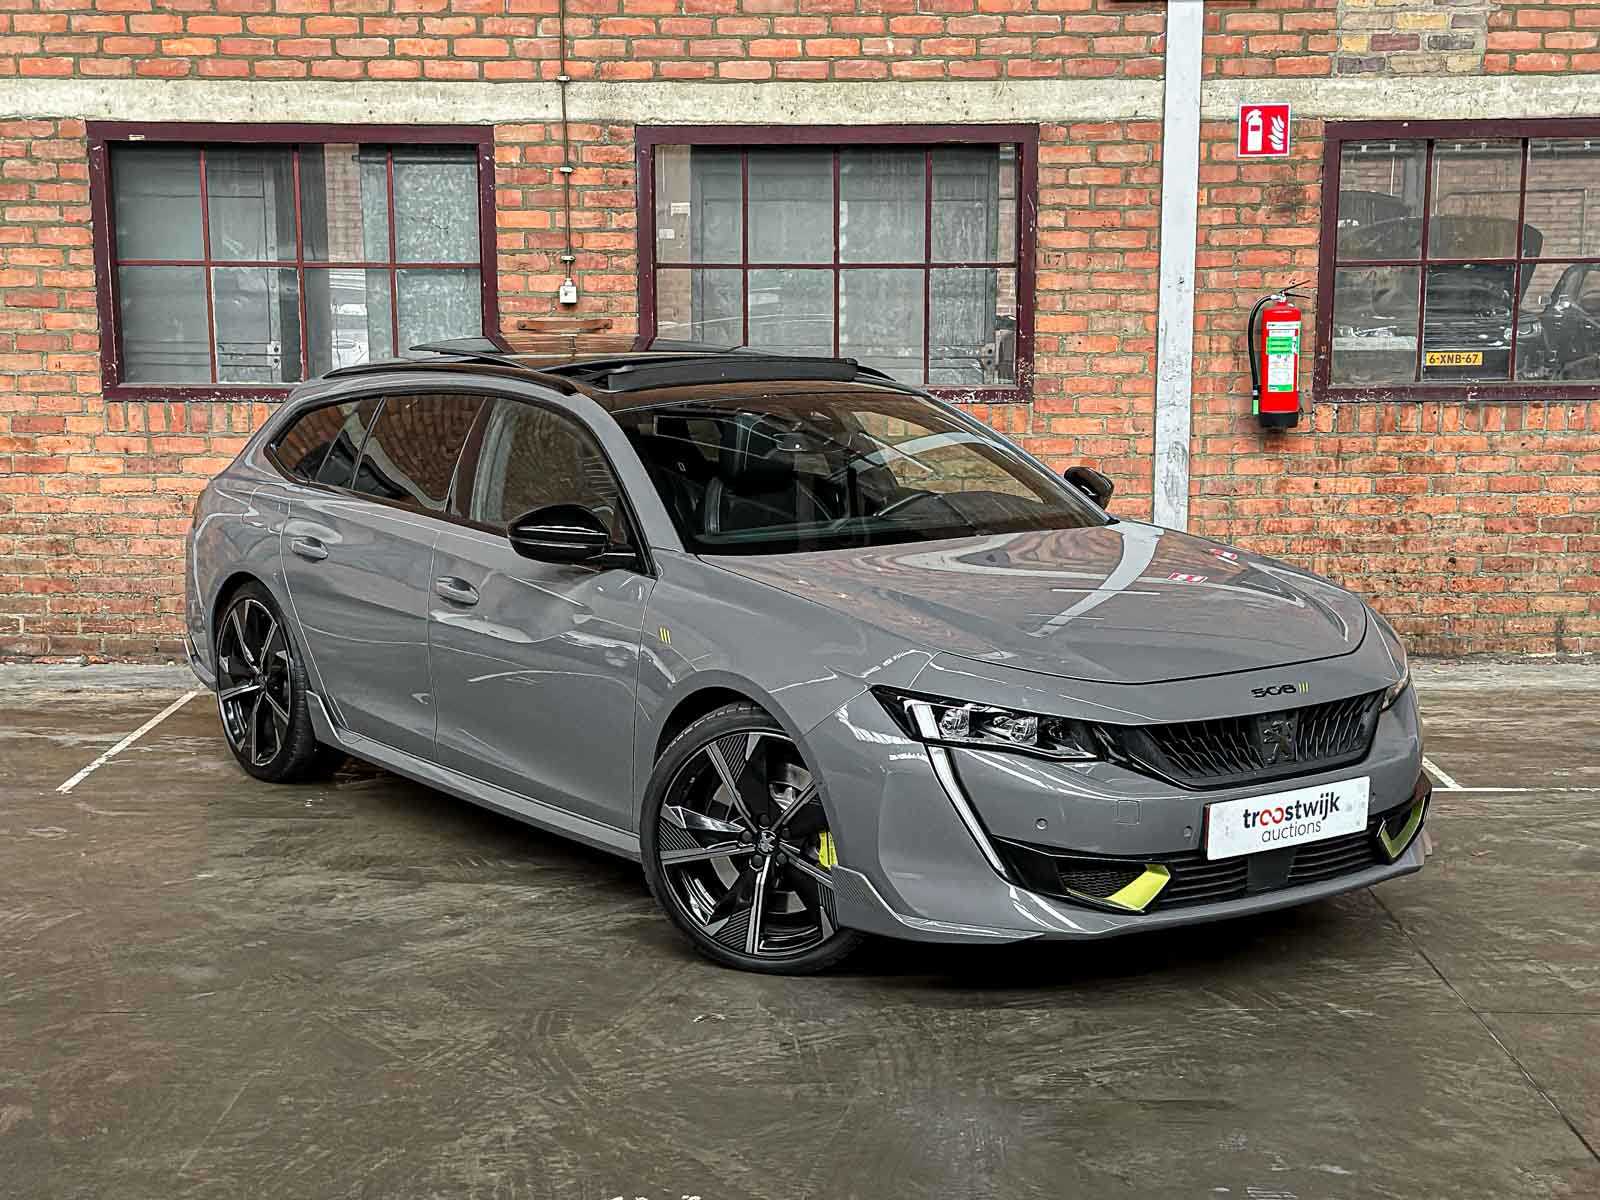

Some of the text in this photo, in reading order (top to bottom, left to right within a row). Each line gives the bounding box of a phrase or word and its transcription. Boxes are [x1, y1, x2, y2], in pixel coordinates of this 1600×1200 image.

[1429, 354, 1479, 364] 6-XNB-67
[1251, 684, 1297, 698] 508
[1243, 792, 1340, 828] troostwijk
[1261, 820, 1322, 843] auctions
